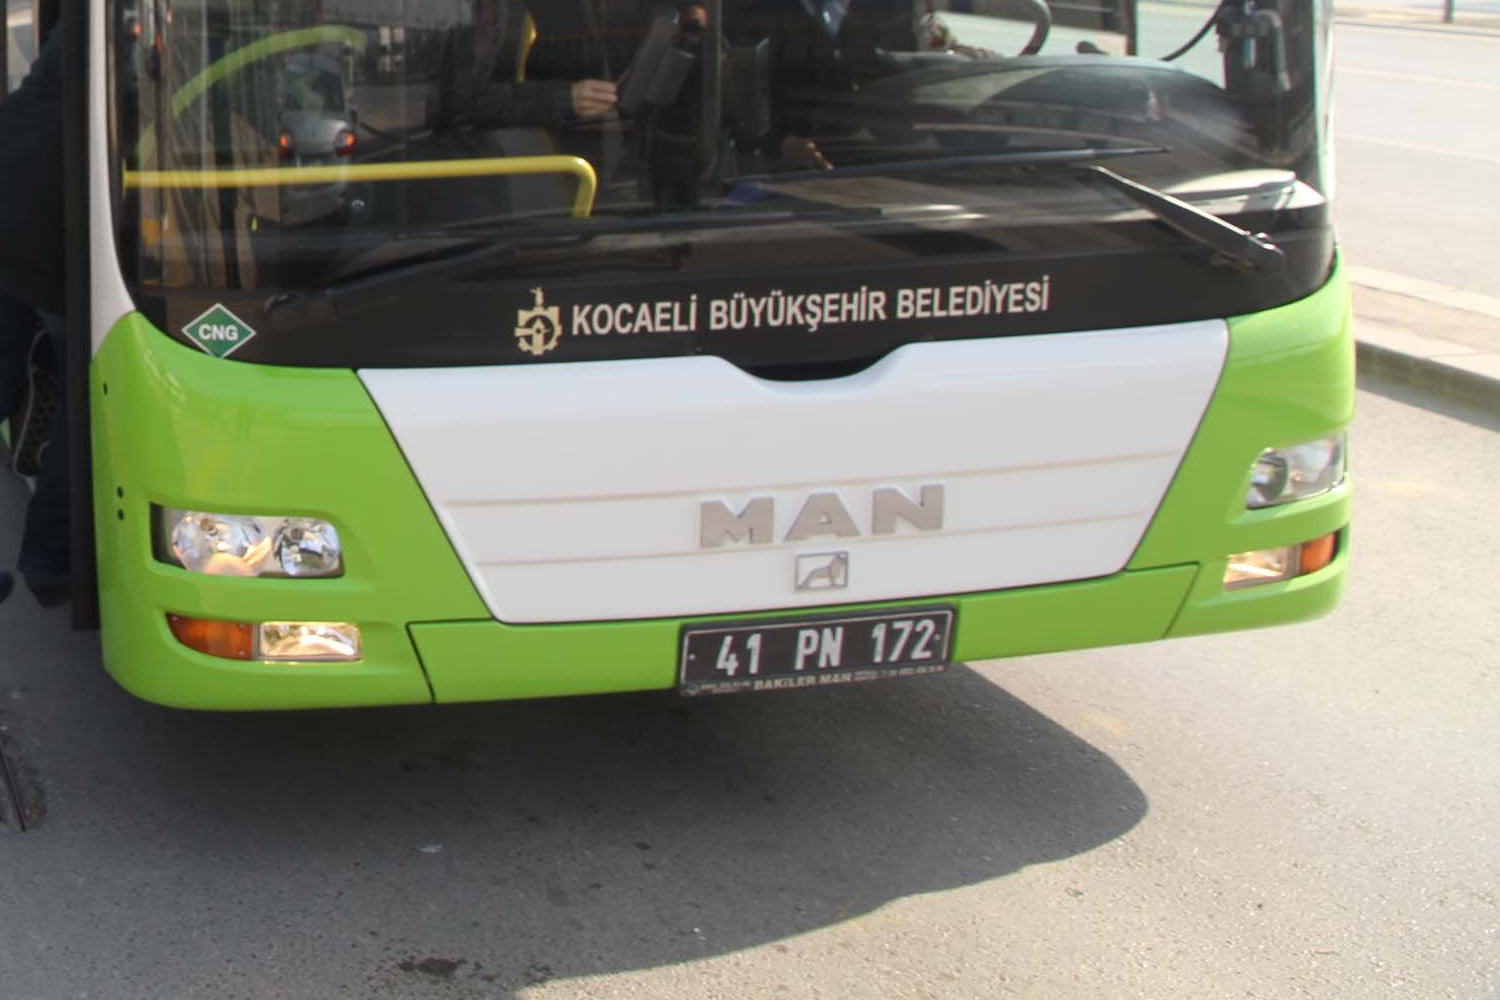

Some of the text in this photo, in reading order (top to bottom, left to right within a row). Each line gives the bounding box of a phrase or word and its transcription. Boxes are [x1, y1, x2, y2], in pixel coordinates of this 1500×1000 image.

[198, 323, 239, 341] CNG
[572, 274, 1050, 336] KOCAELİ BÜYÜKŞEHİR BELEDİYESİ
[700, 483, 945, 549] MAN
[715, 618, 937, 676] 41 PN 172
